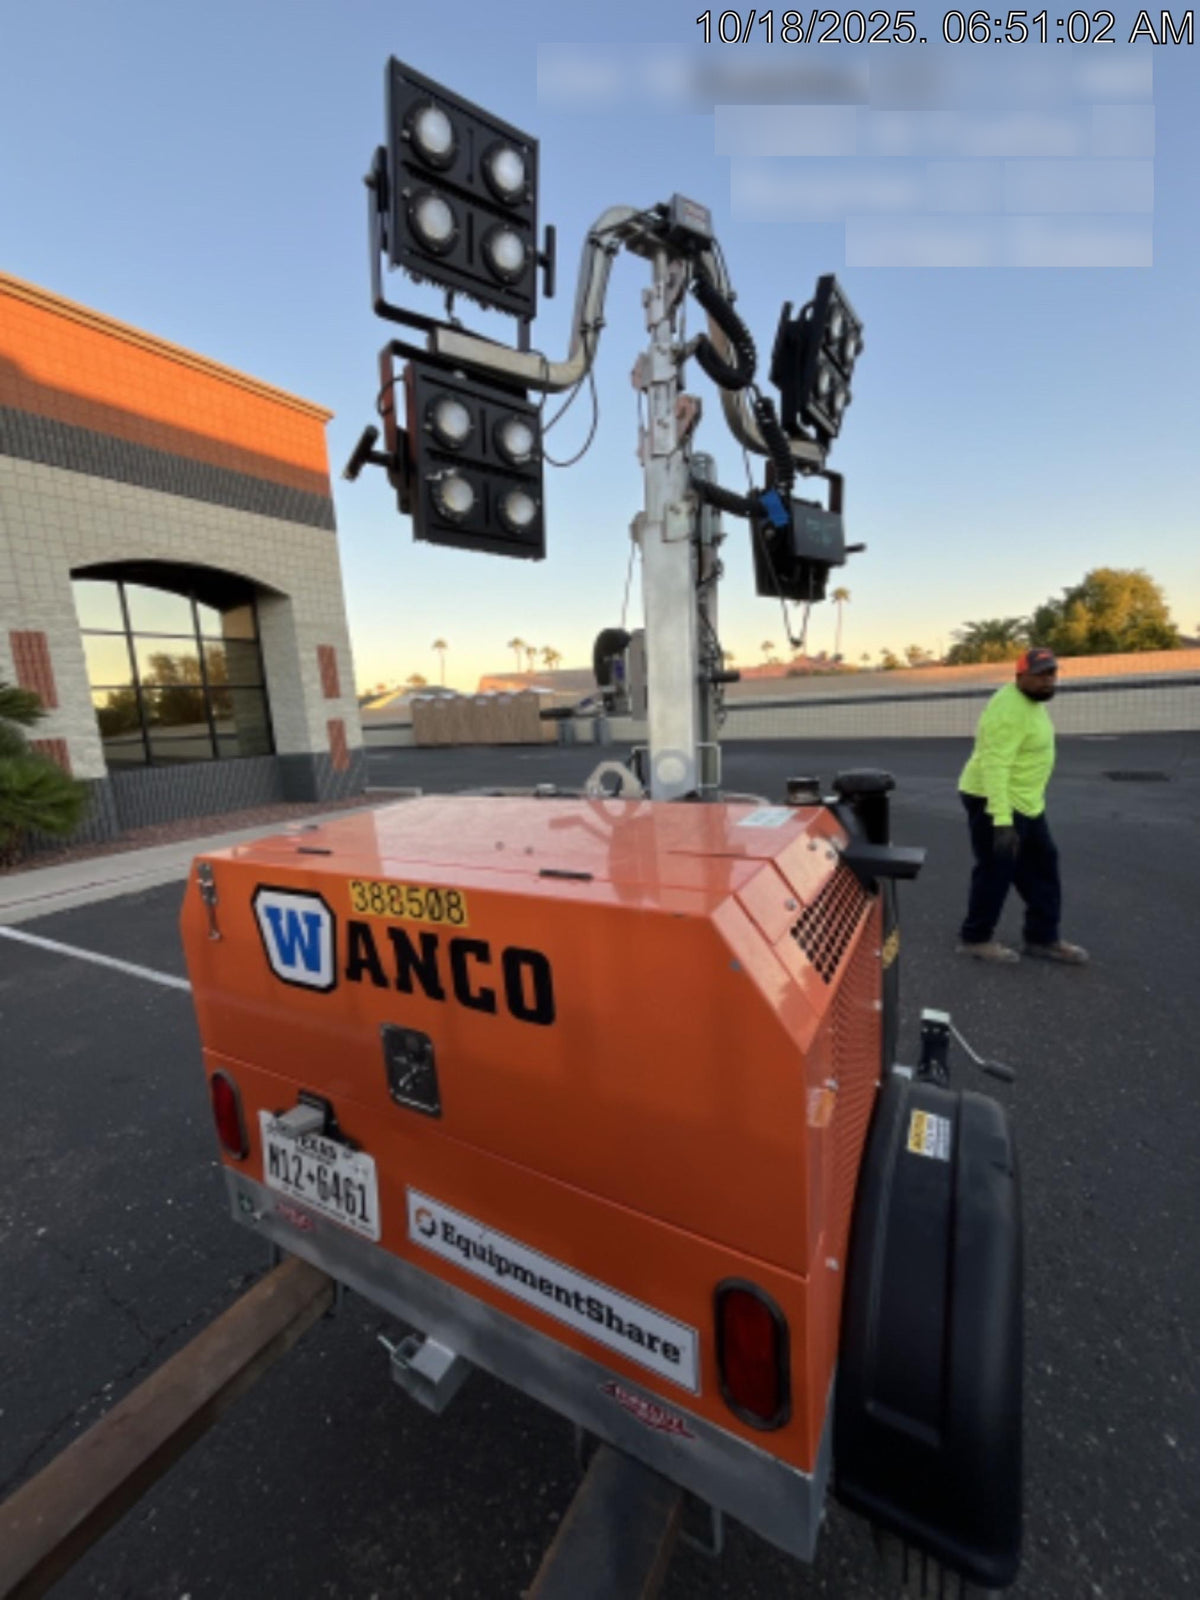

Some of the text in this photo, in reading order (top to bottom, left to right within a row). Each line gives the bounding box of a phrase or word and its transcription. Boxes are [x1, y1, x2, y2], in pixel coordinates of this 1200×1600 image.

[260, 900, 556, 1026] WANCO
[351, 881, 465, 925] 388508
[441, 1221, 682, 1366] EquipmentShare
